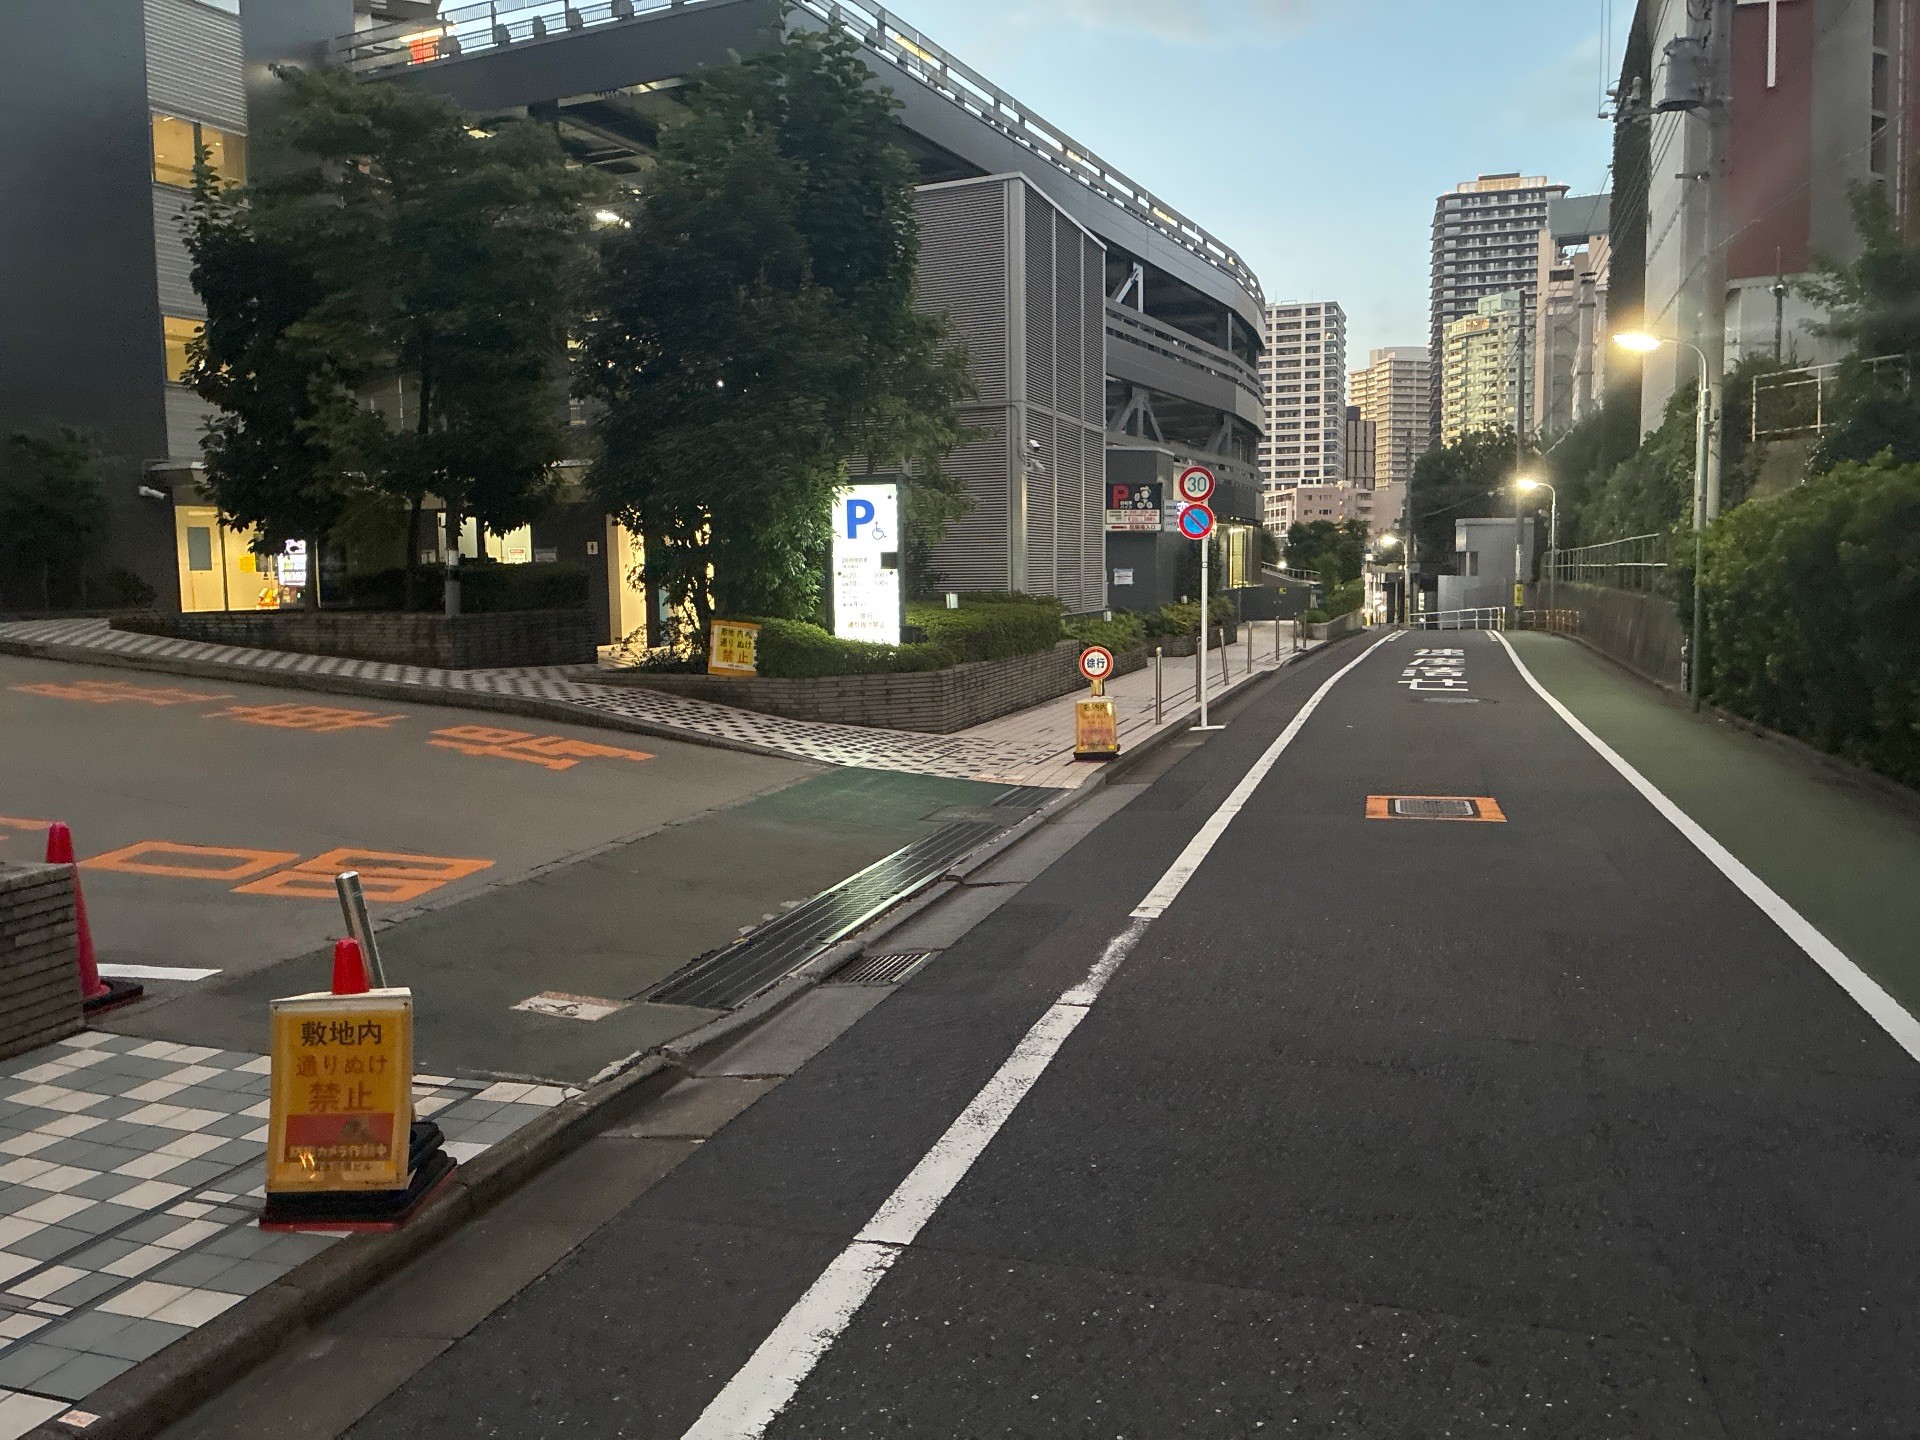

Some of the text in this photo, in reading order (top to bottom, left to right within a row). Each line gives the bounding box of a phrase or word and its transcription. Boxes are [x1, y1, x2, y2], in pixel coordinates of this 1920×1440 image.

[1112, 484, 1130, 509] P
[1187, 477, 1207, 493] 30
[846, 499, 875, 539] P
[719, 637, 752, 650] 通りぬけ
[722, 648, 749, 664] 禁止
[1086, 658, 1106, 669] 徐行
[301, 1020, 383, 1047] 敷地内
[296, 1054, 389, 1078] 通りぬけ
[308, 1081, 375, 1112] 禁止
